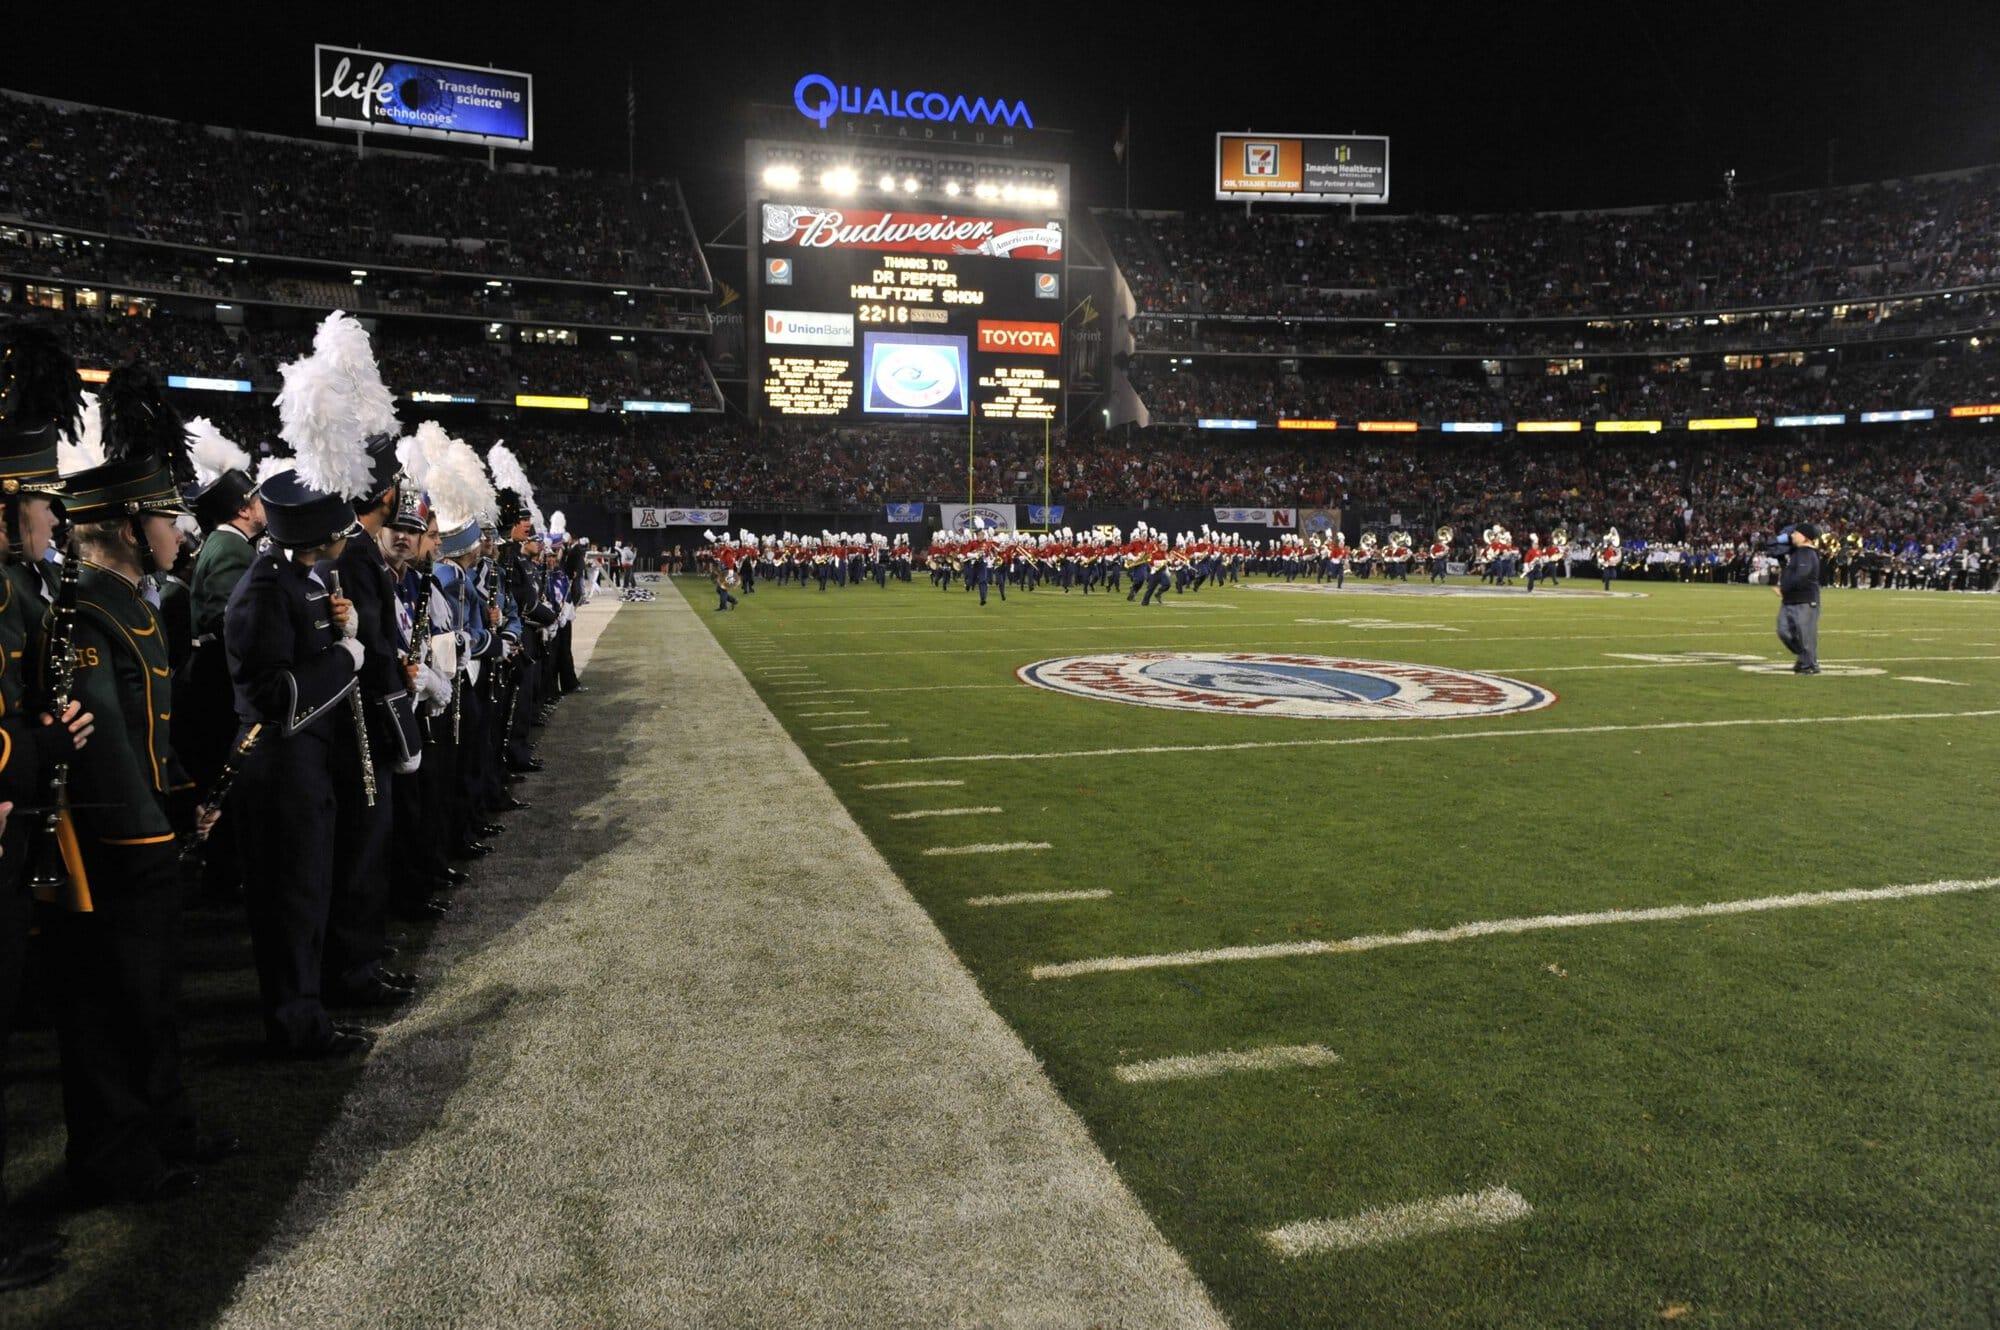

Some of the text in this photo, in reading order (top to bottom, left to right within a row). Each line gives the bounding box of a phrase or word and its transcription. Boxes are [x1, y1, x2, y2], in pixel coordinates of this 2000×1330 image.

[322, 57, 394, 119] life
[437, 79, 521, 102] Transforming
[457, 94, 502, 109] science
[794, 73, 1033, 128] QUALCOMM
[847, 122, 1014, 144] STADIUM
[1305, 163, 1382, 175] Imaging Healthcare
[1324, 180, 1346, 188] Partner
[1355, 180, 1376, 188] Health
[791, 213, 993, 247] Budweiser
[996, 235, 1034, 250] American
[883, 256, 948, 271] THANKS TO
[873, 270, 958, 288] DR PEPPER
[851, 285, 984, 305] HALFTIME SHOW
[710, 312, 744, 326] Sprint
[859, 305, 909, 322] 22:16
[788, 324, 852, 336] UnionBank
[981, 329, 1056, 347] TOYOTA
[640, 509, 660, 527] A
[1272, 509, 1291, 526] N
